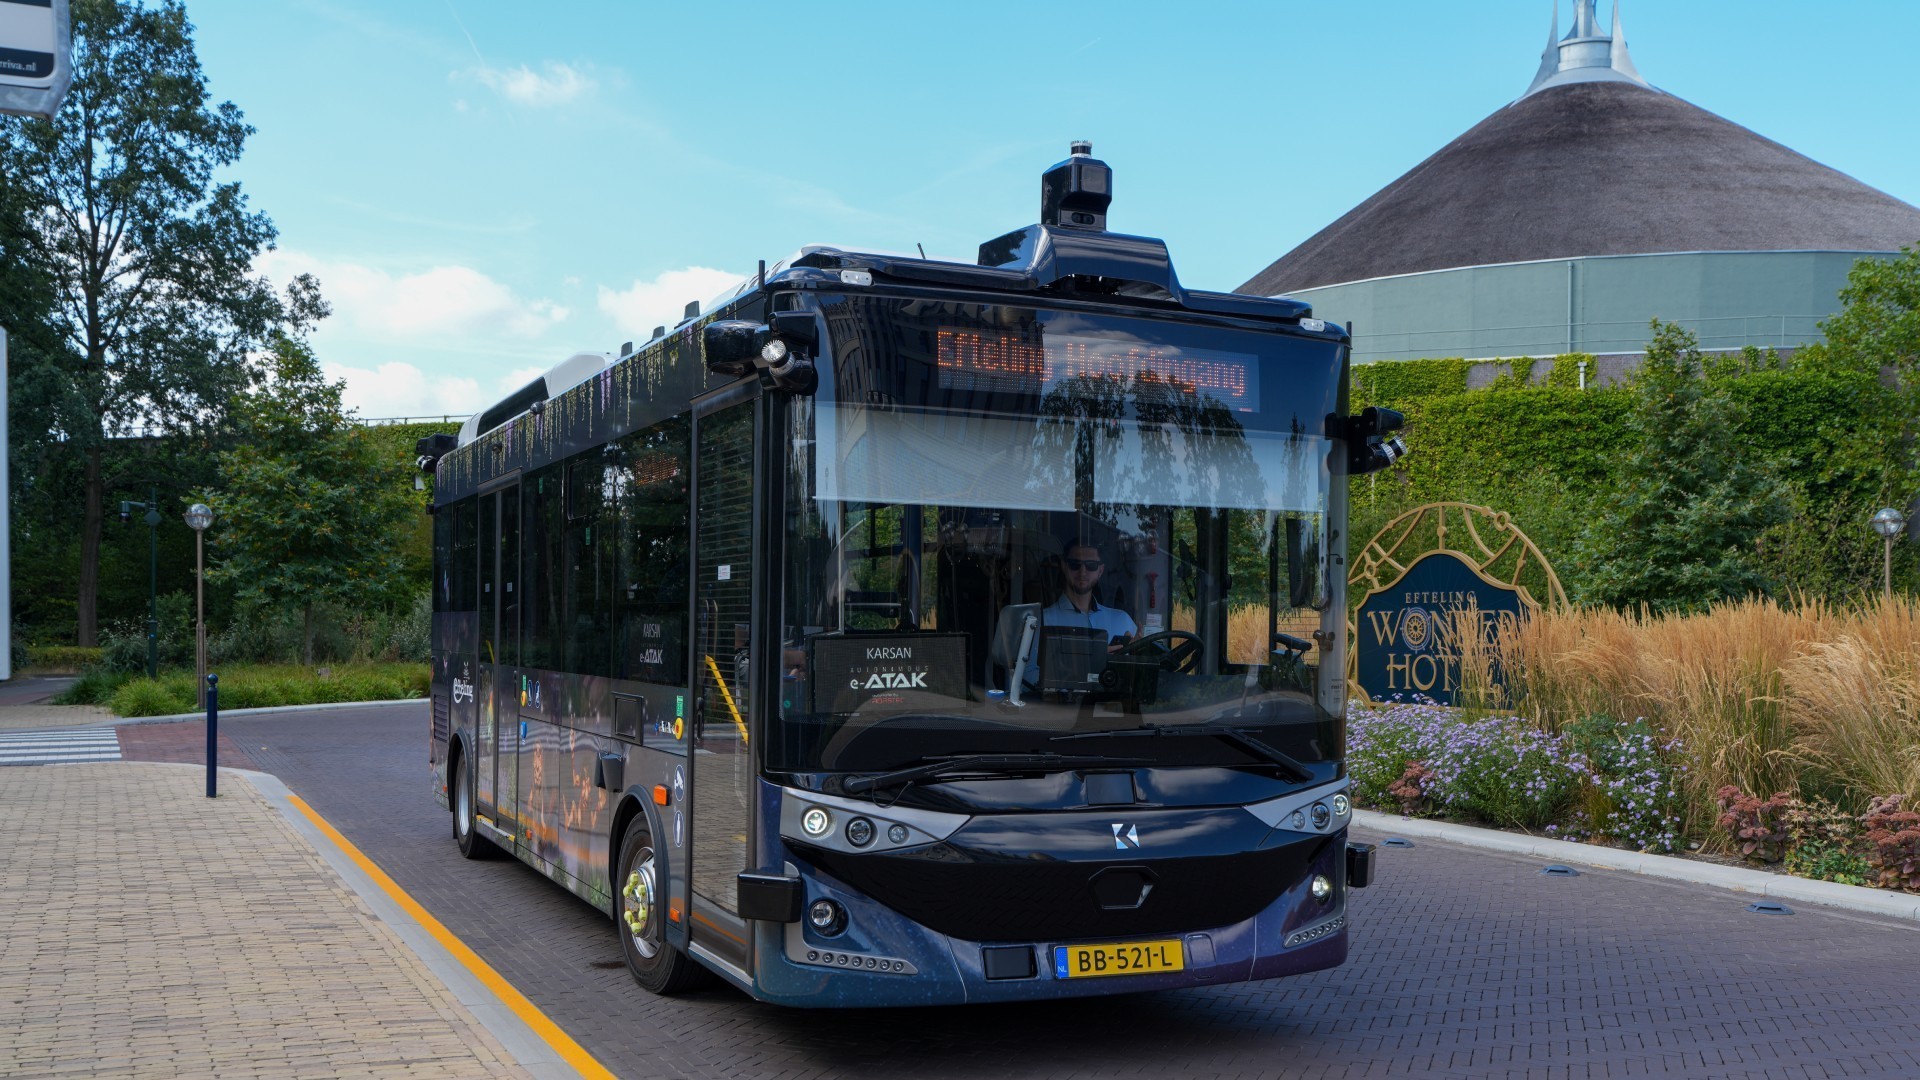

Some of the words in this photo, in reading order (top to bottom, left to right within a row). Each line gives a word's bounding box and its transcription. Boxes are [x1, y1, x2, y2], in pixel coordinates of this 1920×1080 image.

[937, 331, 1053, 381] Efteling
[1067, 343, 1246, 396] Hoofdingang
[1405, 590, 1477, 604] EFTELING
[866, 647, 912, 660] KARSAN
[849, 671, 929, 690] e-ATAK
[1058, 965, 1068, 973] NL
[1078, 946, 1173, 972] BB-521-L
